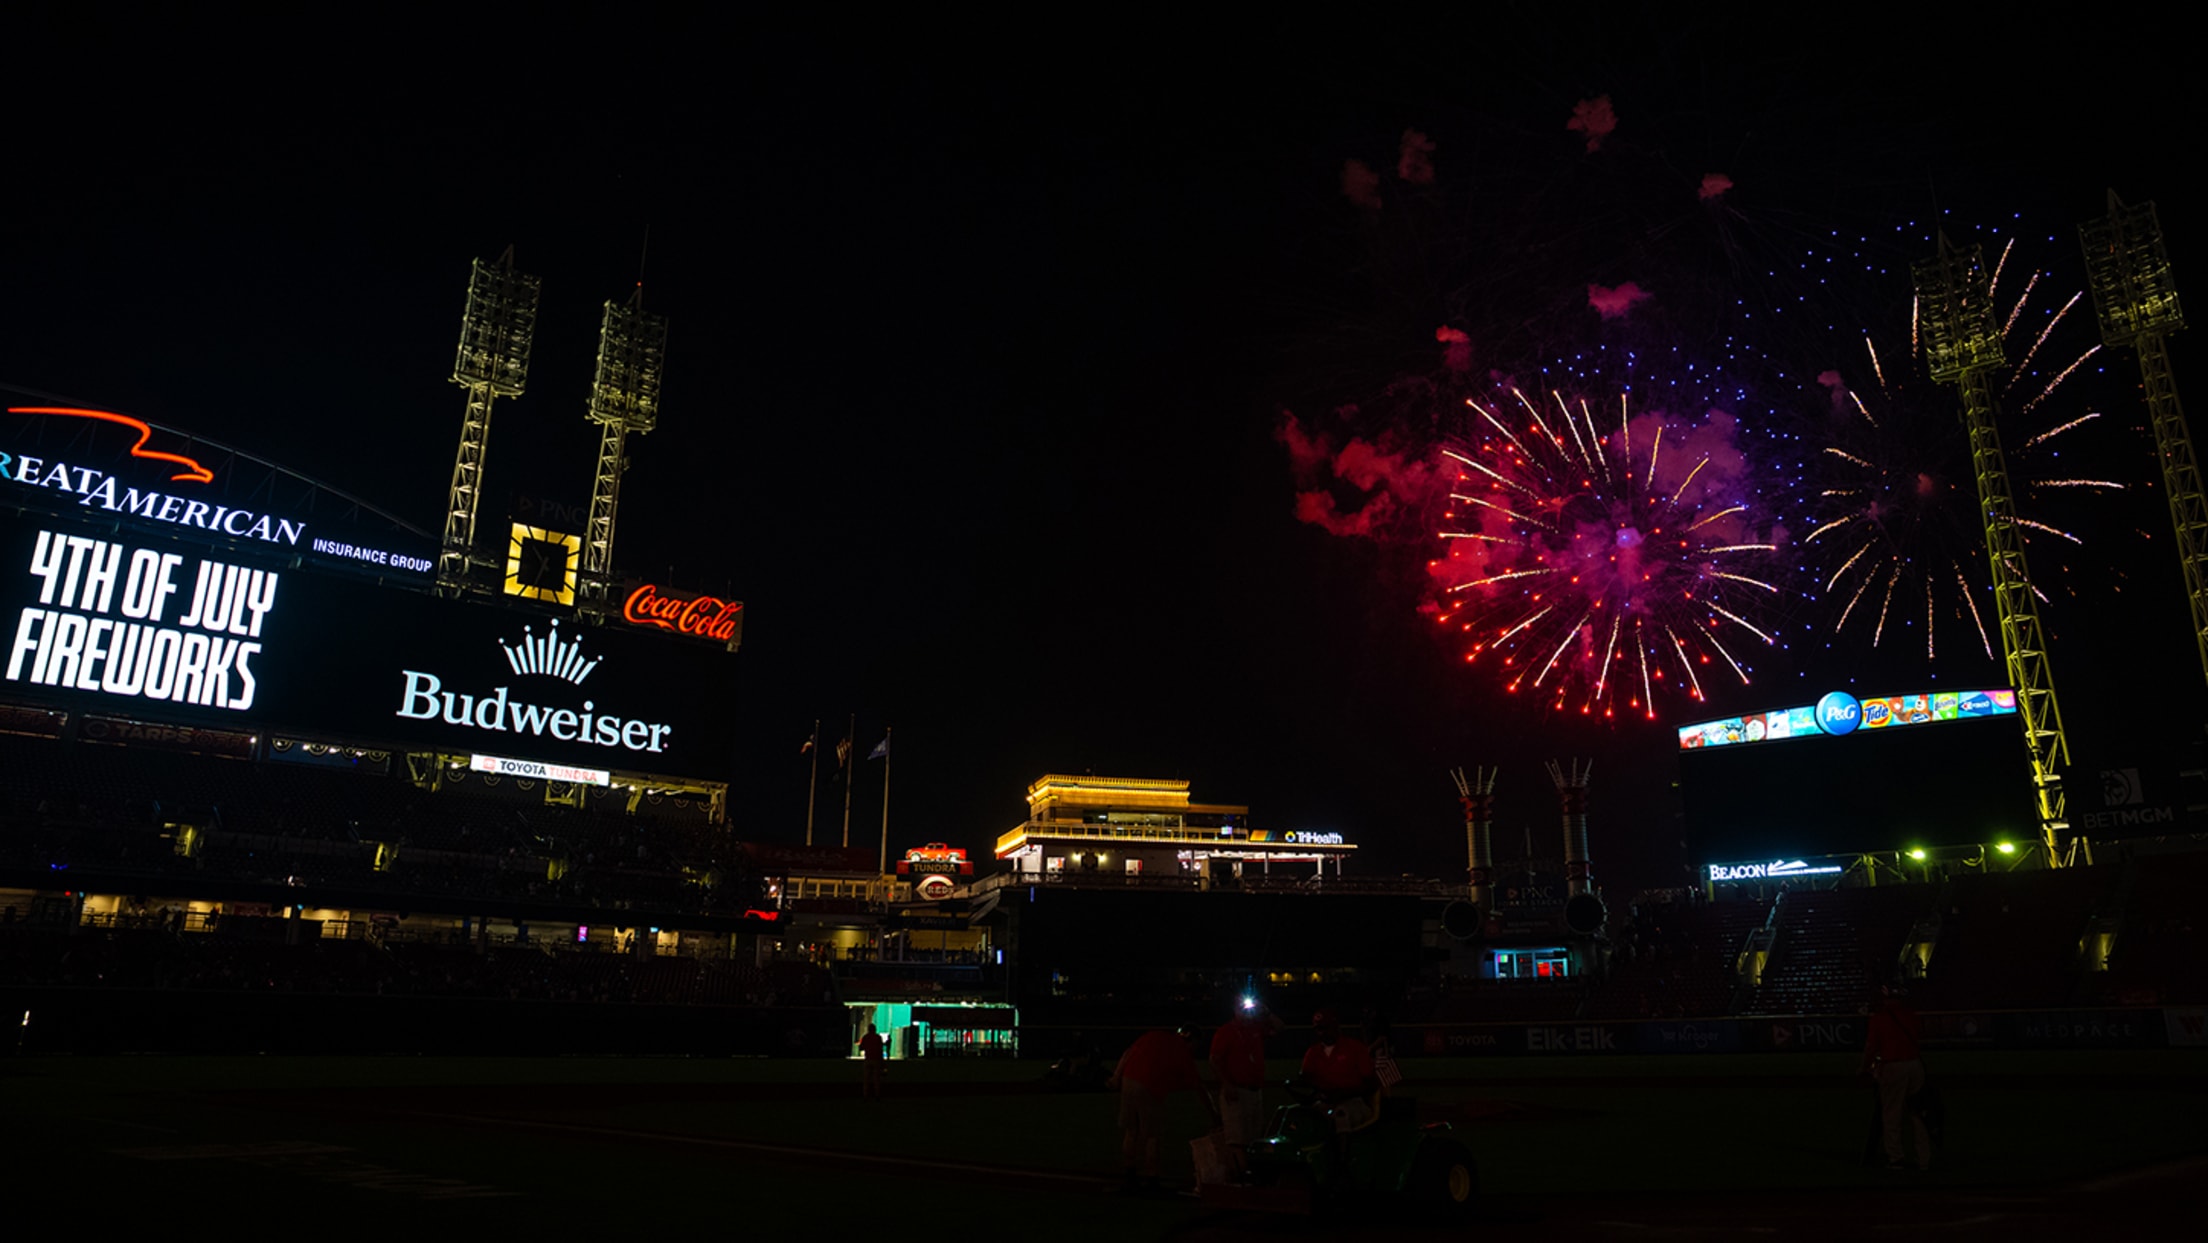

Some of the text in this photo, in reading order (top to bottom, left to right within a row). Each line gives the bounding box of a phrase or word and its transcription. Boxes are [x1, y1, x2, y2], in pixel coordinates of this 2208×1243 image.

[541, 499, 588, 527] PNC
[313, 538, 433, 572] INSURANCE GROUP
[30, 530, 279, 637] 4TH OF JULY
[623, 584, 743, 640] Coca-Cola
[5, 607, 262, 711] FIREWORKS
[396, 670, 671, 752] Budweiser
[1826, 704, 1856, 722] P&G
[1864, 704, 1889, 724] Tide
[116, 725, 193, 744] TARPS
[500, 761, 597, 782] TOYOTA TUNDRA
[2081, 805, 2176, 829] BETMGM
[1296, 831, 1343, 844] TriHealth
[913, 863, 956, 873] TUNDRA
[1800, 1023, 1853, 1045] PNC
[2025, 1020, 2136, 1038] MEDPACE
[1448, 1035, 1497, 1046] TOYOTA
